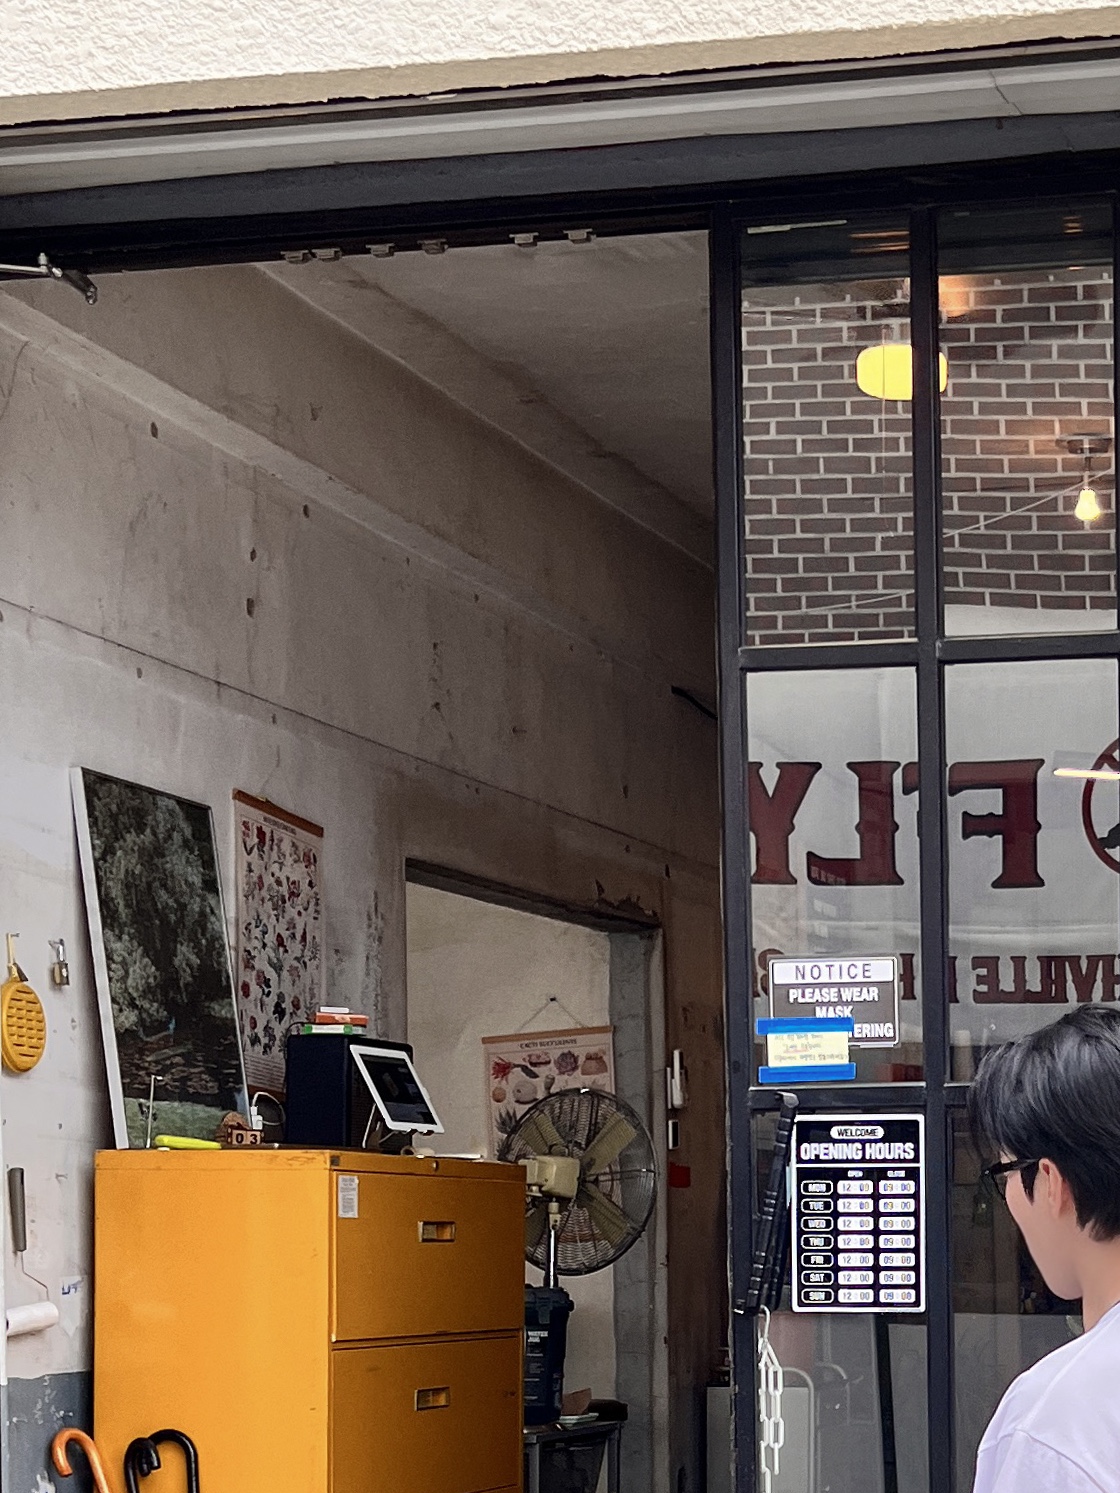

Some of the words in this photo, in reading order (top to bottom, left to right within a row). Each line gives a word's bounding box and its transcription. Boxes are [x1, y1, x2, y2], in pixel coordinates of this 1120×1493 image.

[795, 963, 872, 981] NOTICE
[788, 987, 839, 1004] PLEASE
[839, 986, 879, 1003] WEAR
[814, 1005, 854, 1018] MASK
[848, 1022, 895, 1038] ERING
[837, 1128, 879, 1137] WELCOME
[800, 1142, 863, 1160] OPENING
[865, 1142, 915, 1160] HOURS
[810, 1273, 825, 1283] SAT
